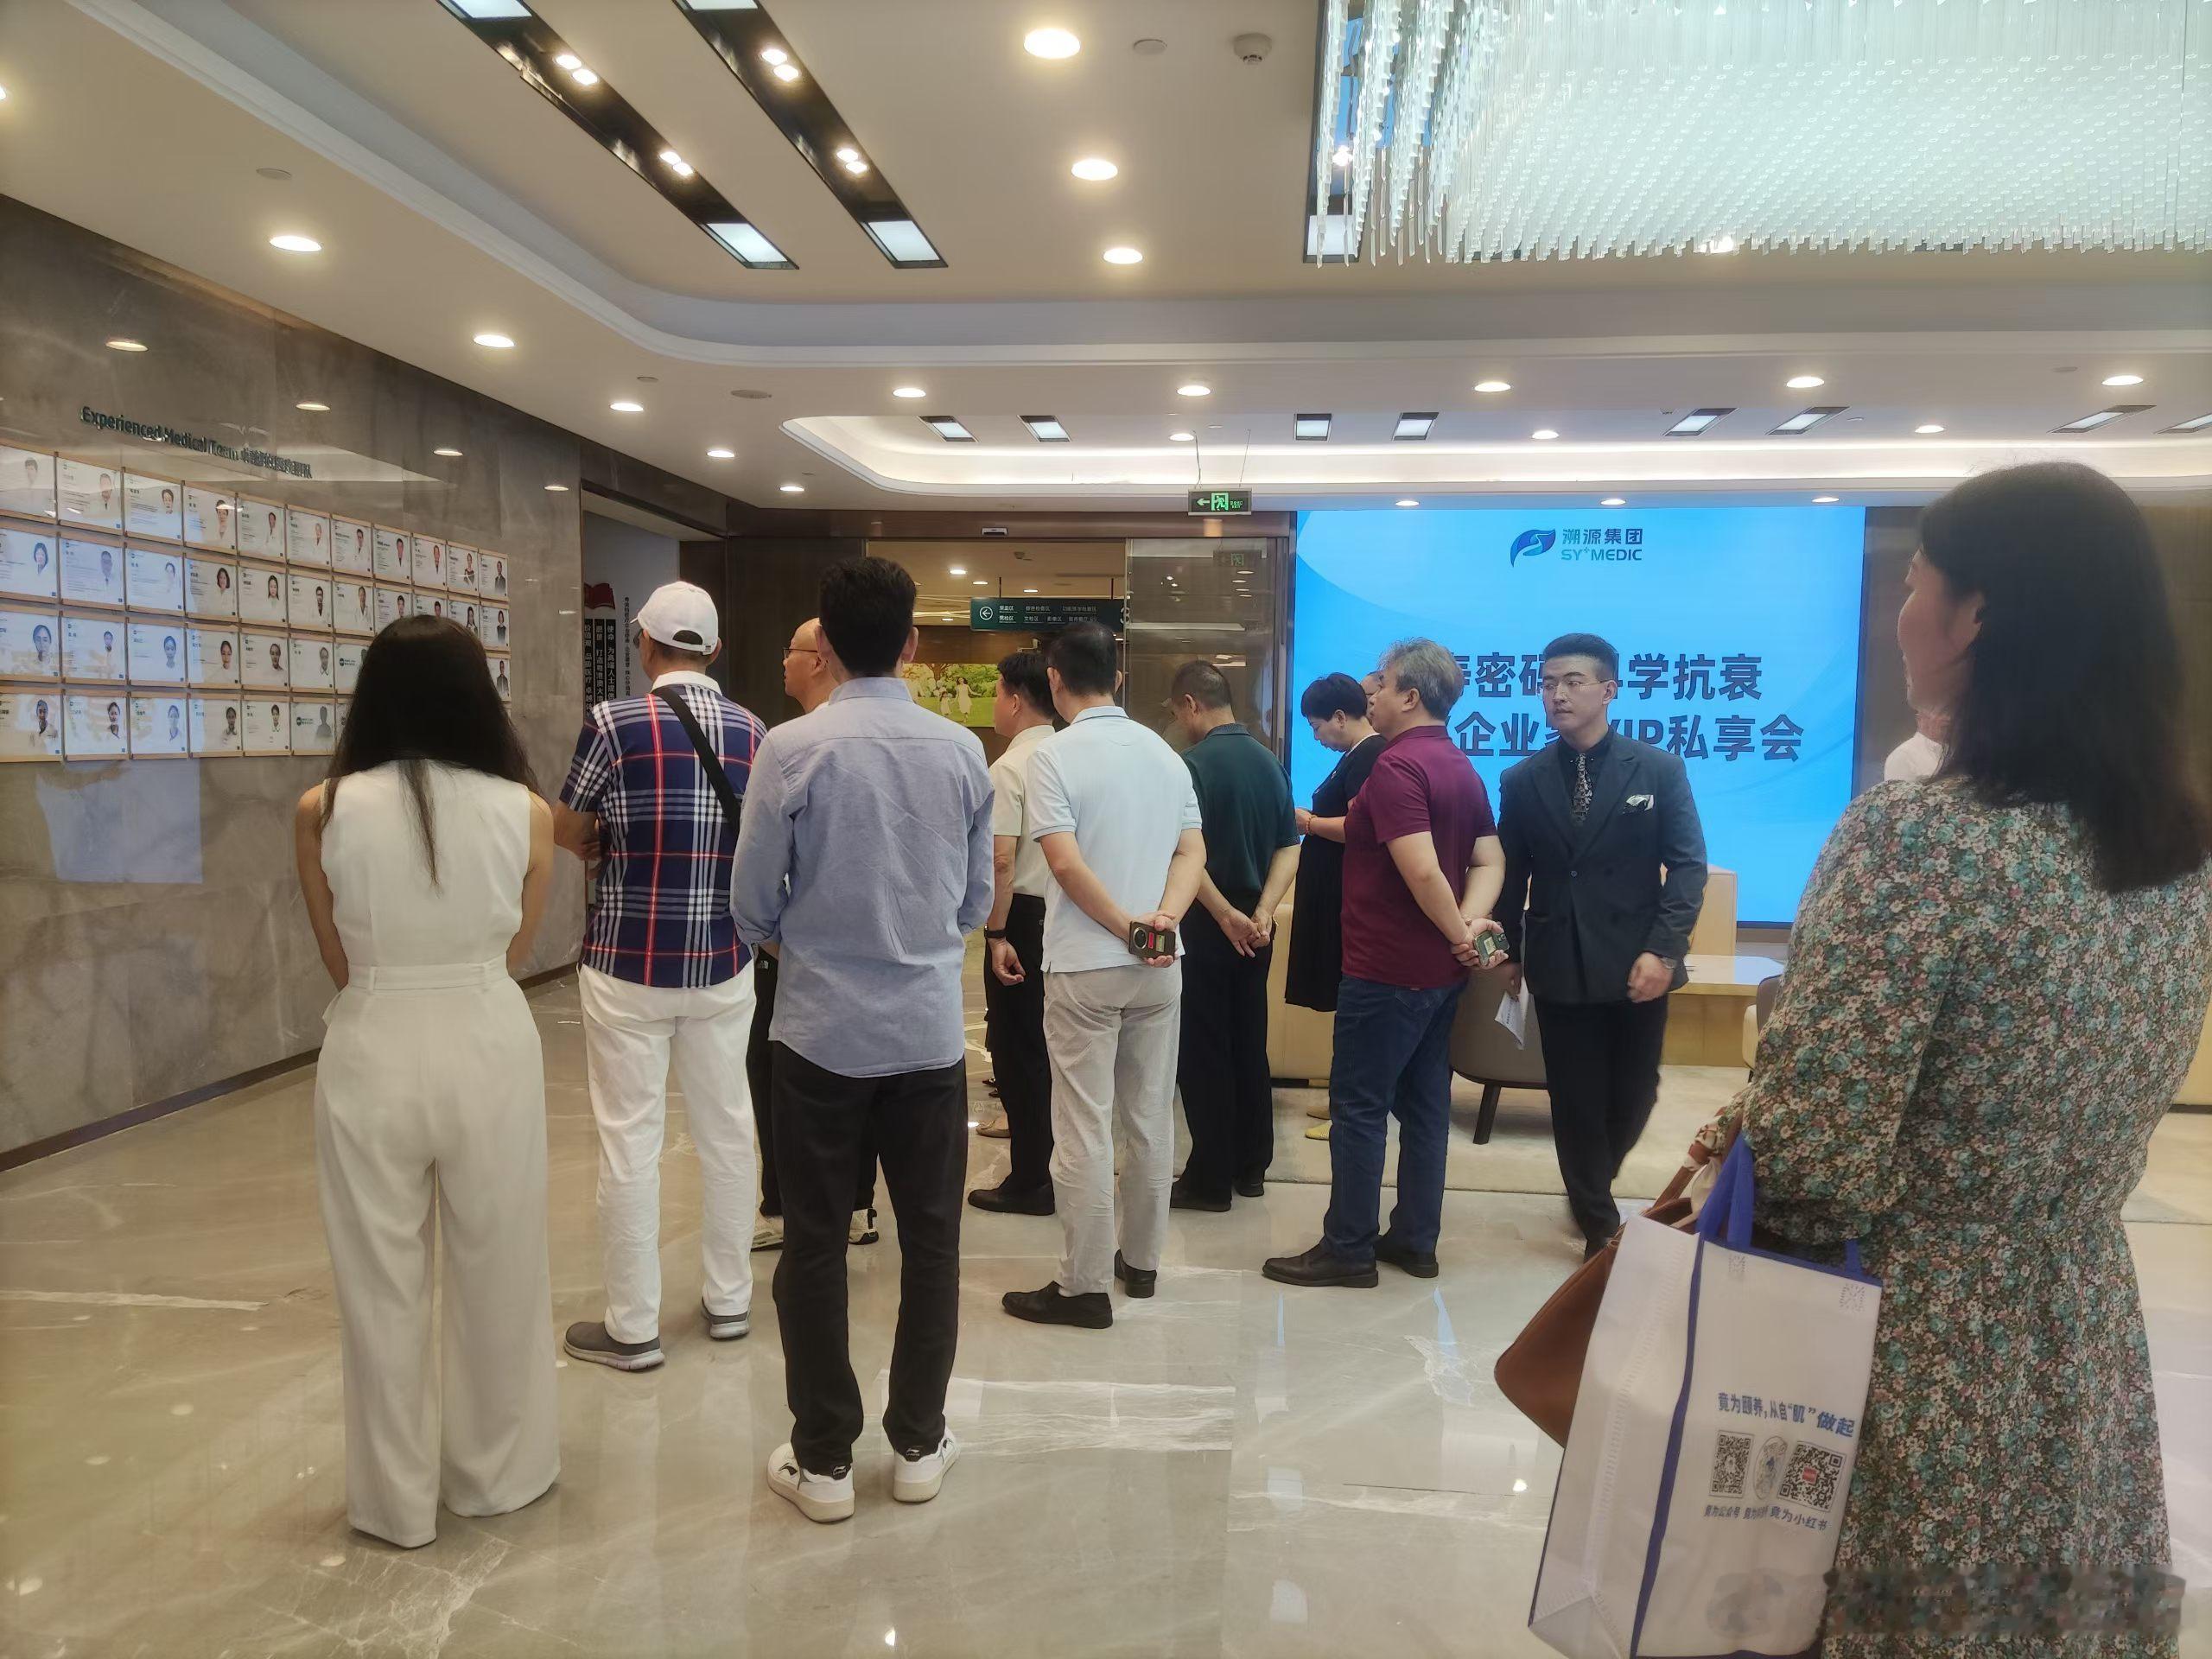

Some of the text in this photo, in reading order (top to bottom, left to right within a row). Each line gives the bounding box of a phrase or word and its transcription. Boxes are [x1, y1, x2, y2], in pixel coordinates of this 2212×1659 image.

[80, 406, 162, 438] Experienced
[163, 427, 207, 452] Medical
[1562, 529, 1643, 545] 溯源集团
[607, 625, 615, 640] 使命
[1770, 1505, 1828, 1530] 竟为小红书
